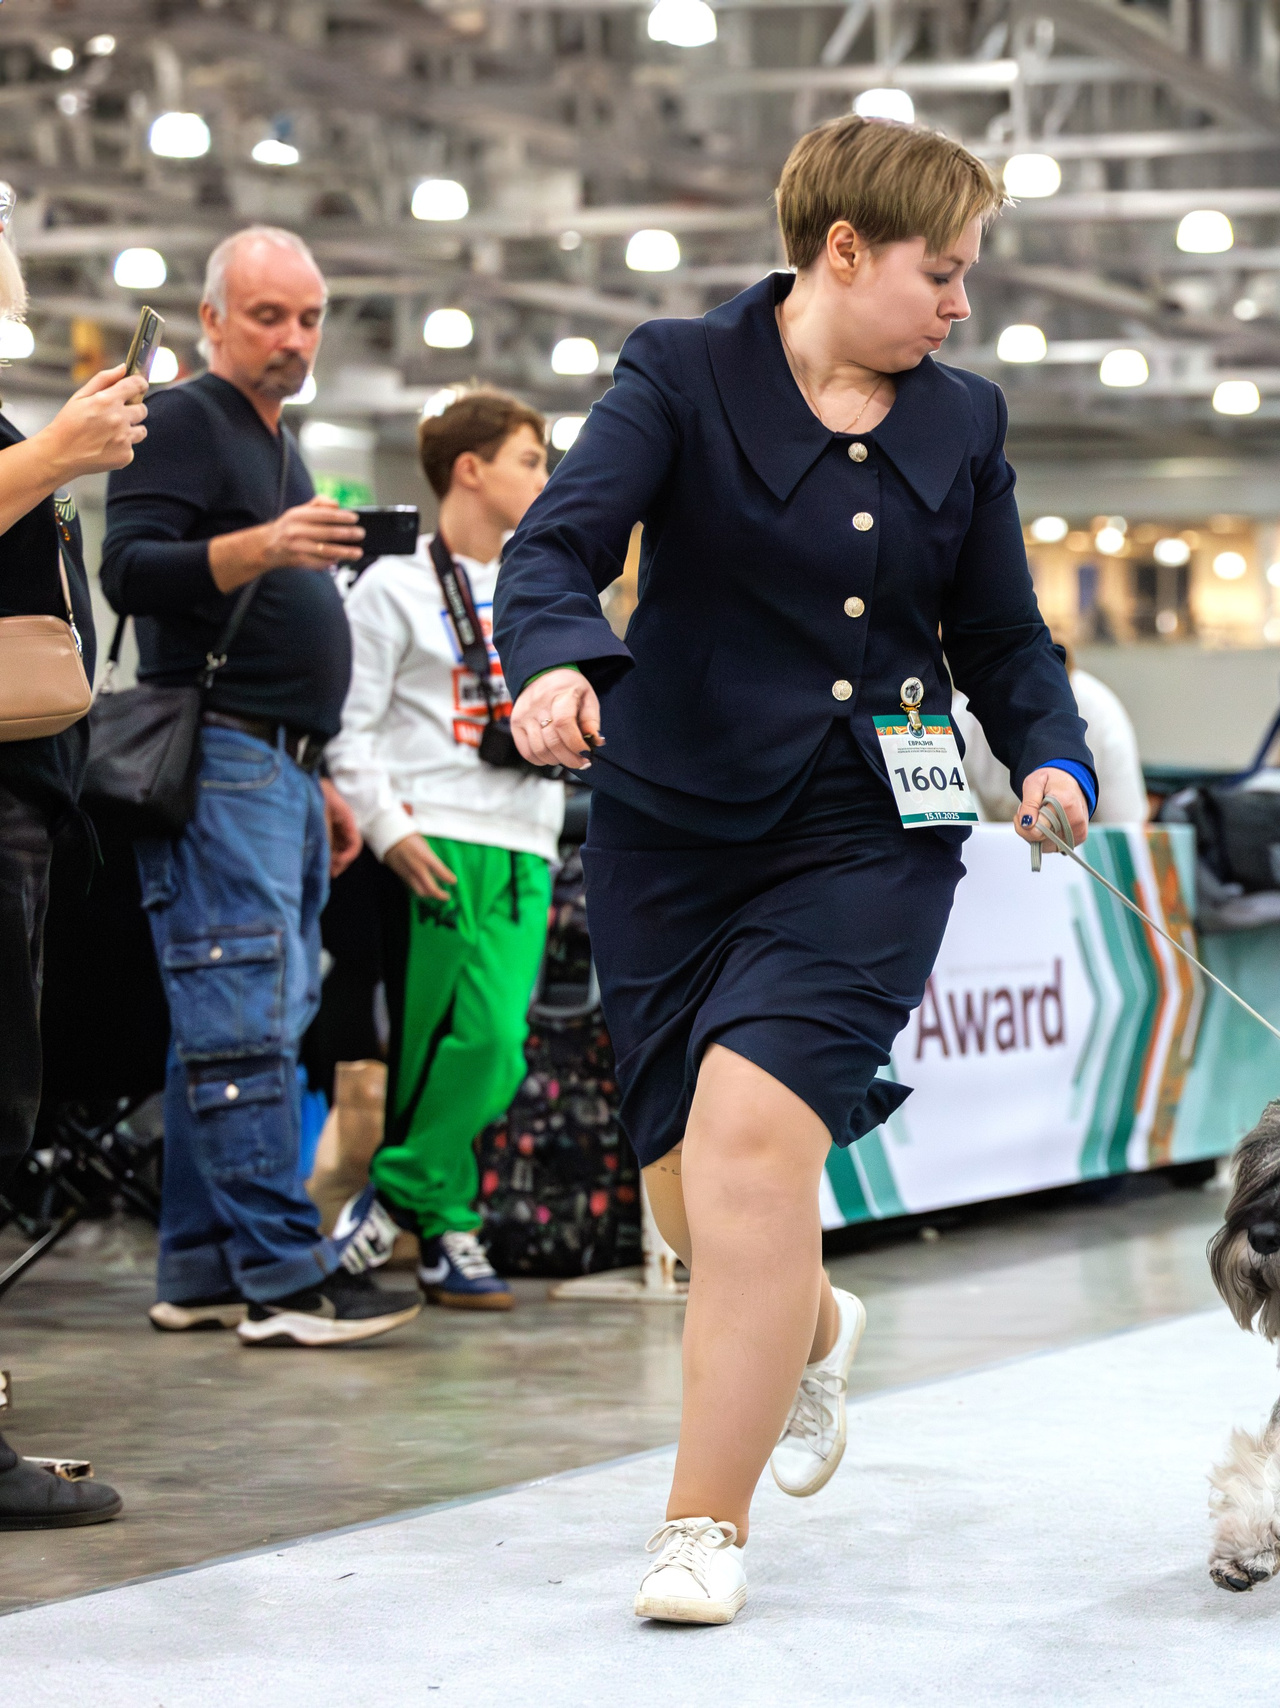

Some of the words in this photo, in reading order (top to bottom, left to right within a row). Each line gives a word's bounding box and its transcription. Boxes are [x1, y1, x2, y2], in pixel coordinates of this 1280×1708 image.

[894, 766, 964, 792] 1604
[925, 812, 960, 820] 15.11.2025
[915, 955, 1064, 1060] Award
